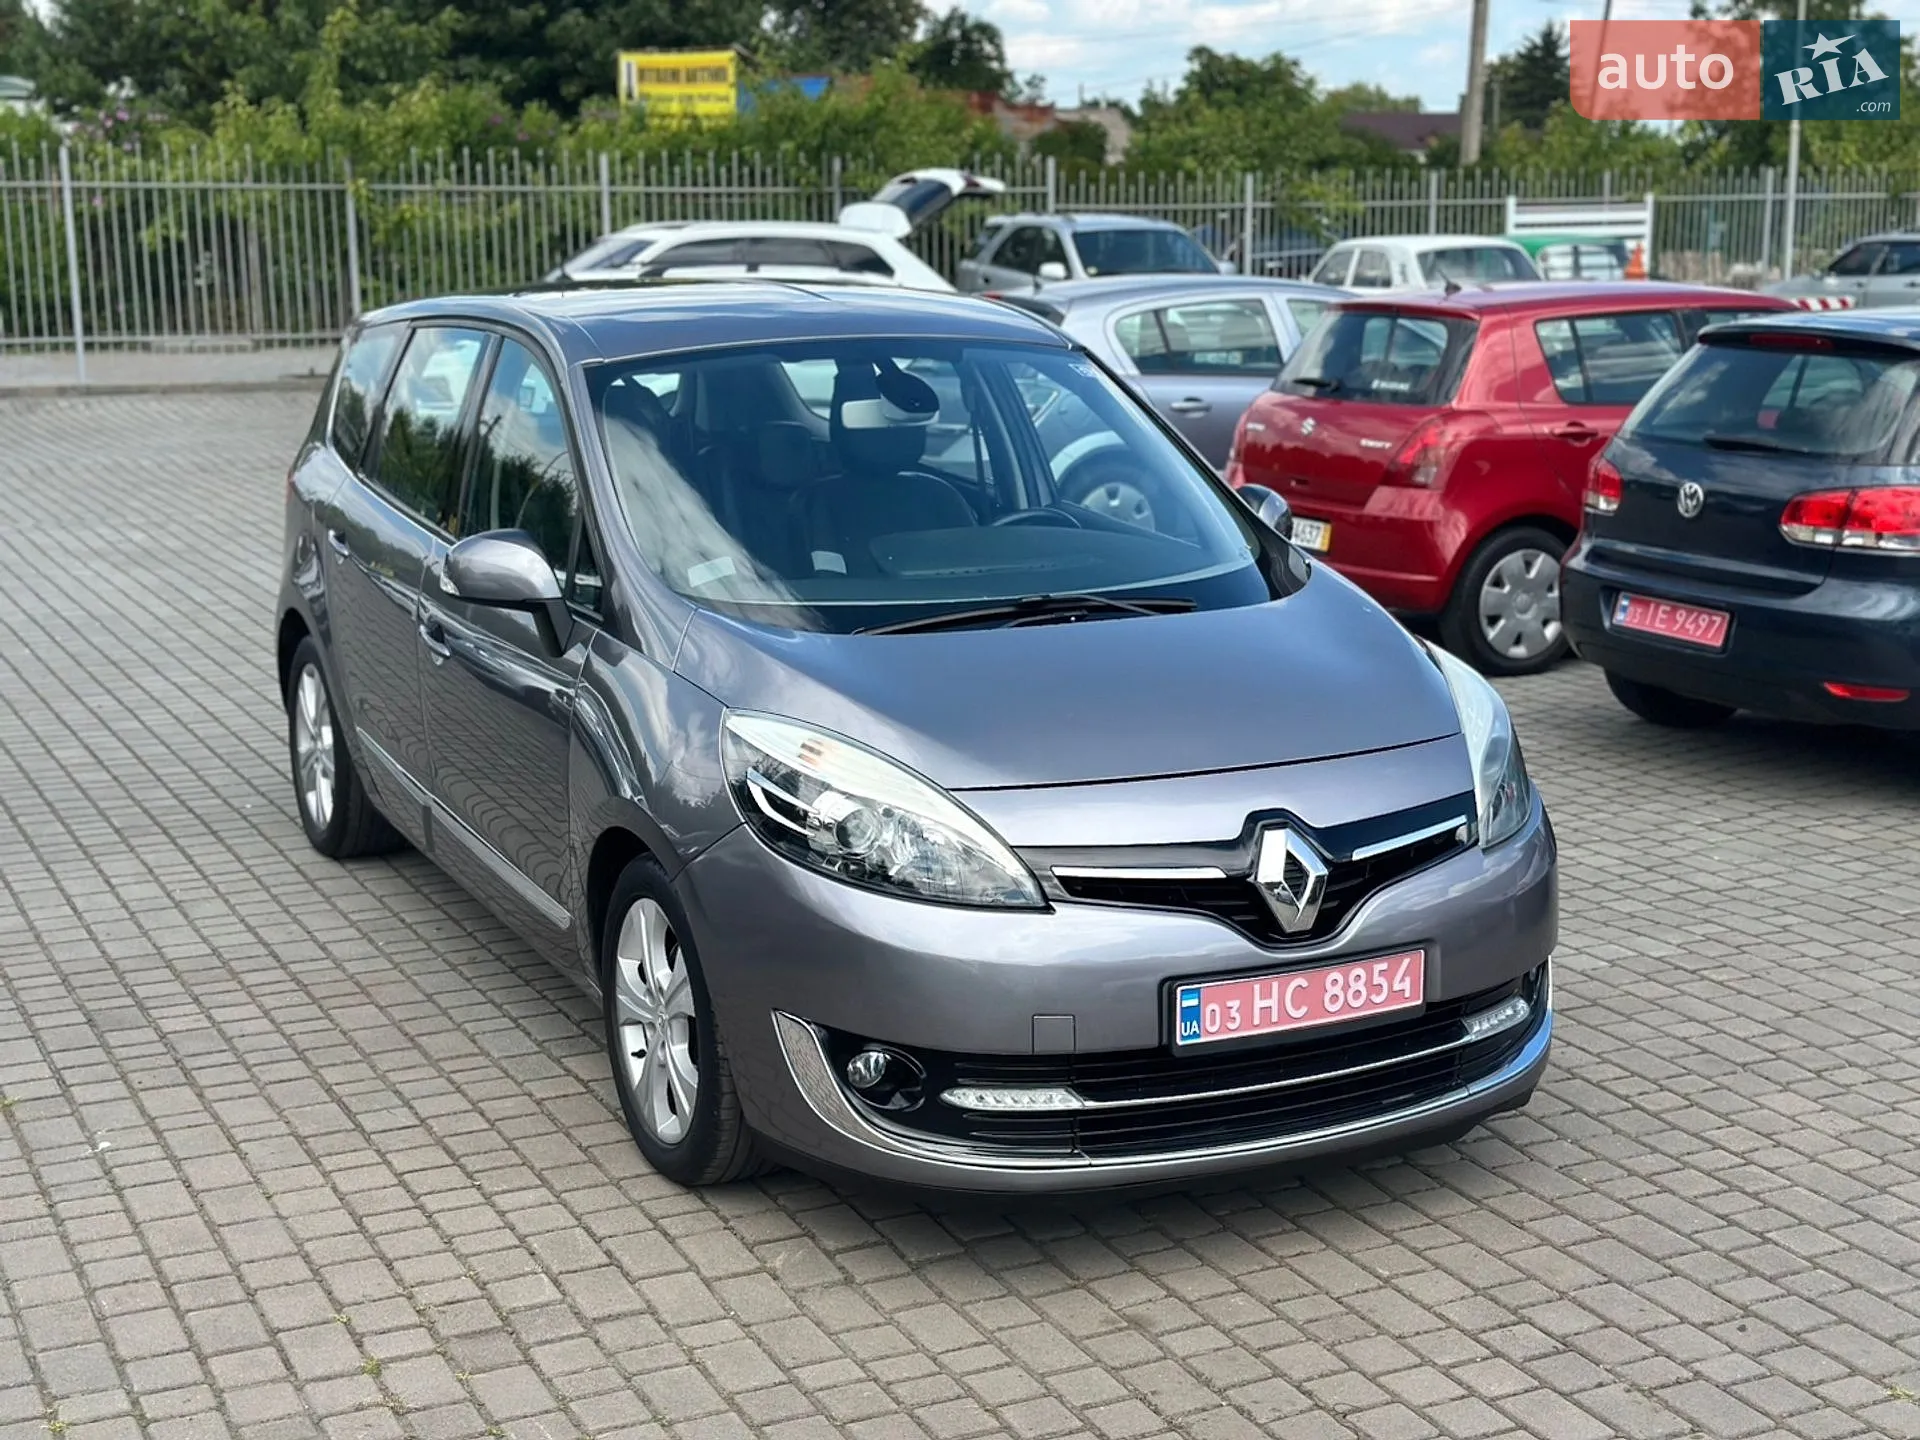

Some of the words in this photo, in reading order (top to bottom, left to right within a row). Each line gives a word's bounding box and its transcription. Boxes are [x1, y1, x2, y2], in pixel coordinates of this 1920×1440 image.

[1673, 609, 1722, 638] 9497
[1205, 999, 1241, 1034] 03
[1253, 978, 1309, 1026] HC
[1323, 958, 1411, 1013] 8854
[1181, 1020, 1200, 1037] UA
